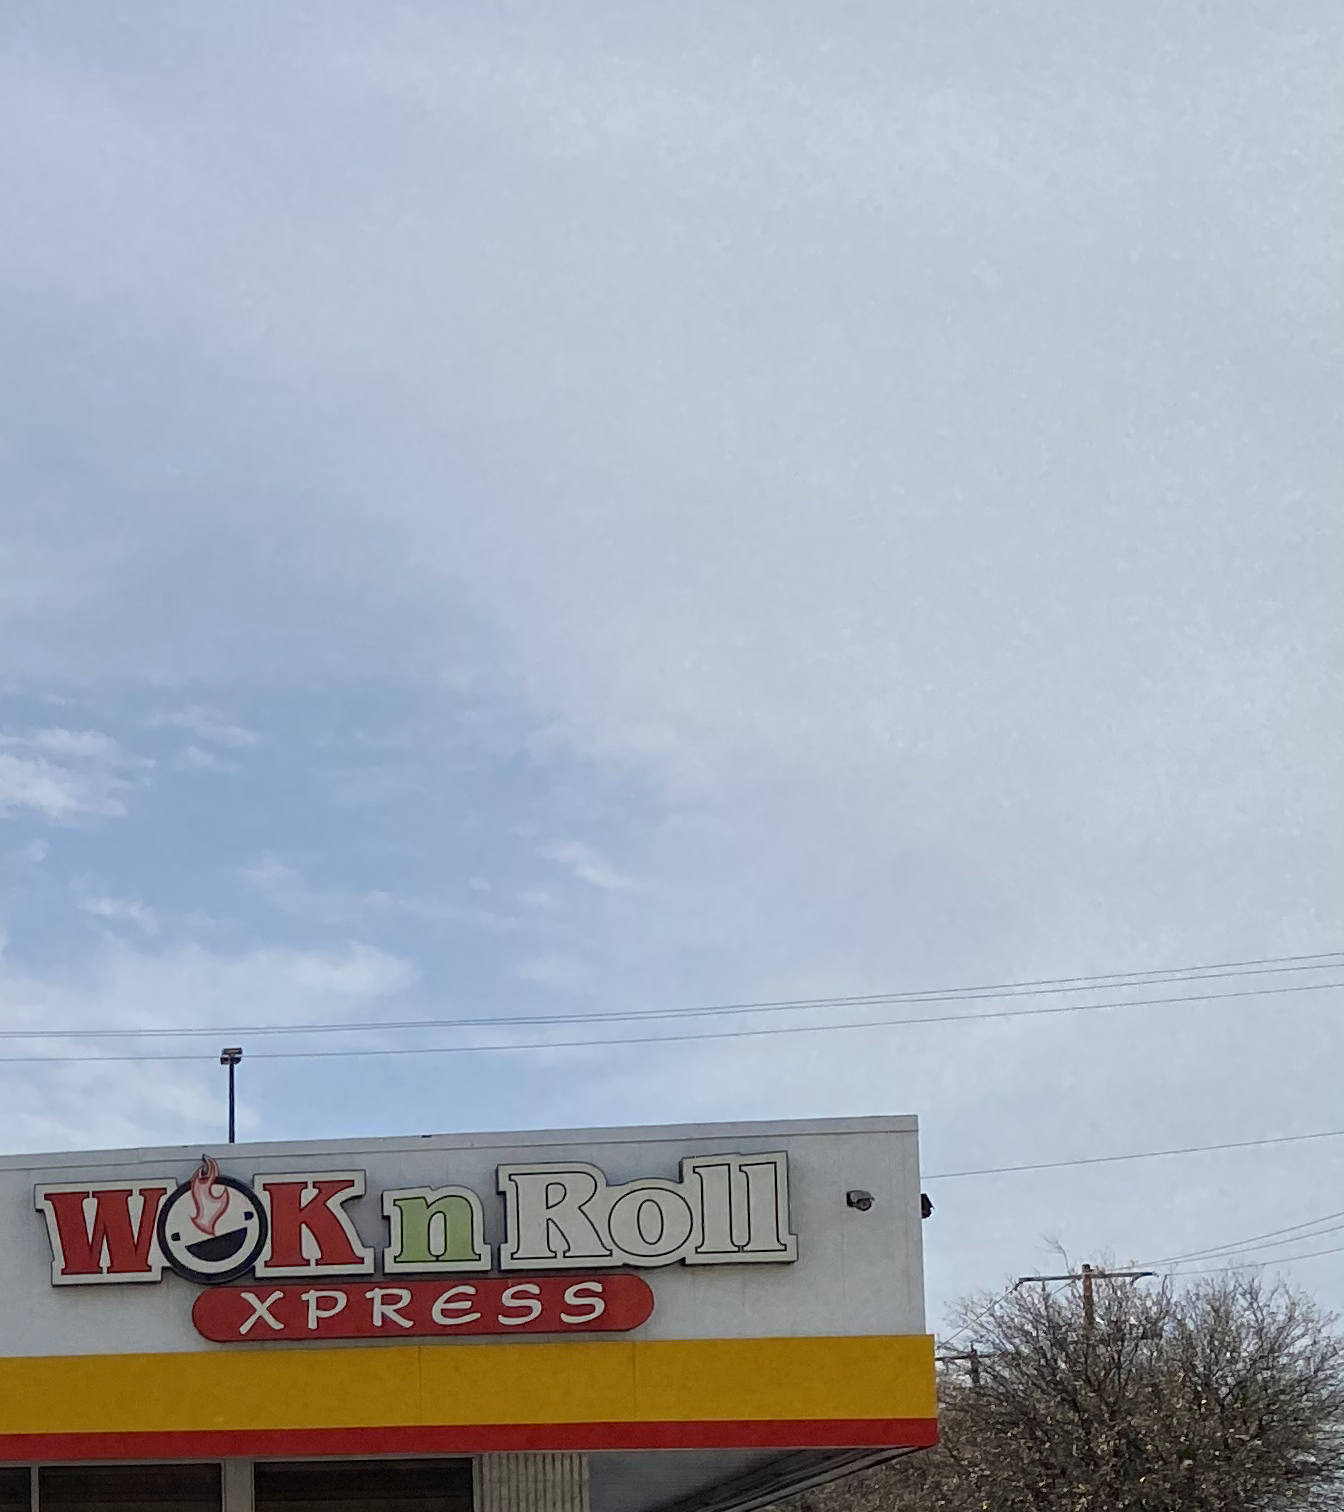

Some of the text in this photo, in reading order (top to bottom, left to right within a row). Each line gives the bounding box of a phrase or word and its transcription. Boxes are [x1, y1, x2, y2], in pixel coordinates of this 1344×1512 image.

[391, 1192, 484, 1265] n
[506, 1160, 789, 1261] Roll
[238, 1281, 607, 1336] XPRESS
